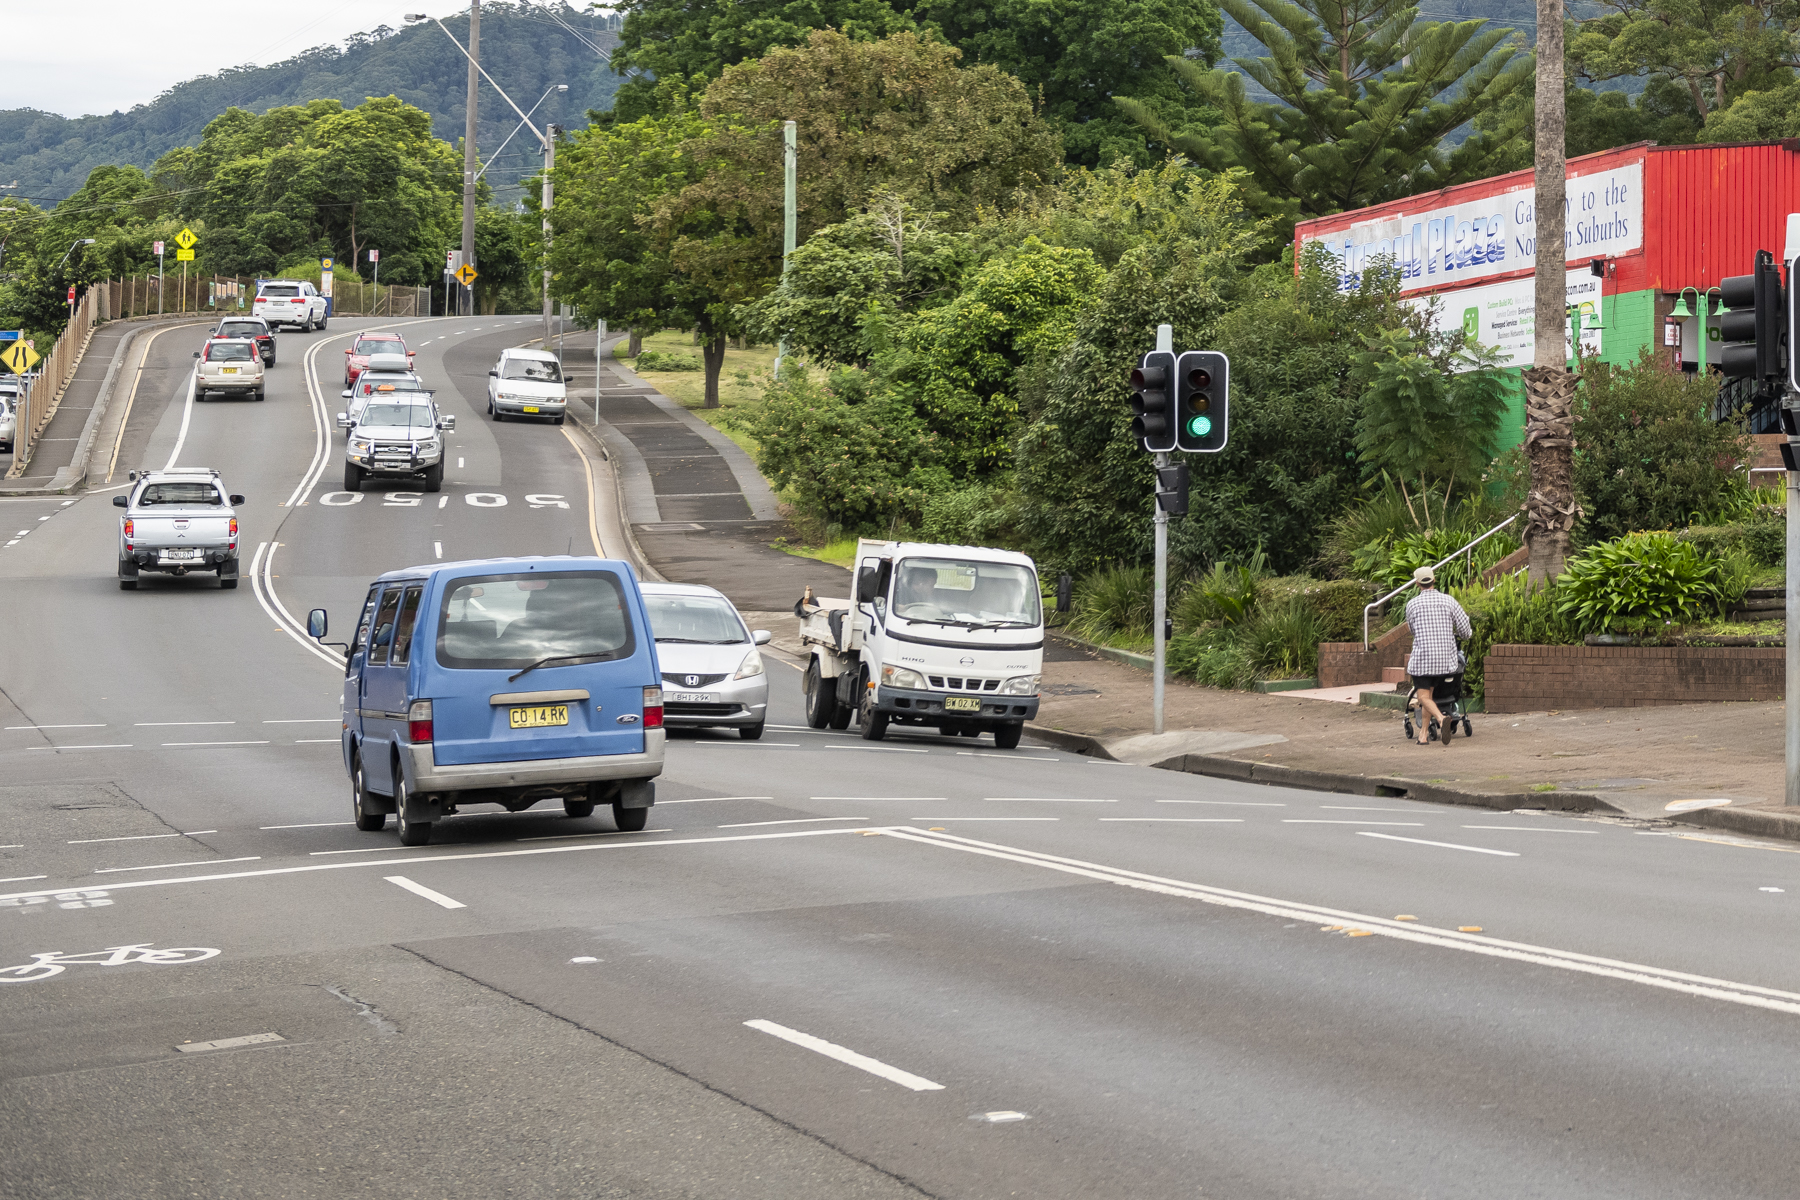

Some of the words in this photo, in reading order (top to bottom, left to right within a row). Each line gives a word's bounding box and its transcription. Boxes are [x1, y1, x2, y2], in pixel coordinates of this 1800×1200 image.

[1582, 191, 1595, 212] to
[1605, 177, 1628, 207] the
[1428, 213, 1506, 275] Plaza
[1576, 210, 1629, 247] Suburbs
[901, 656, 925, 664] HINO
